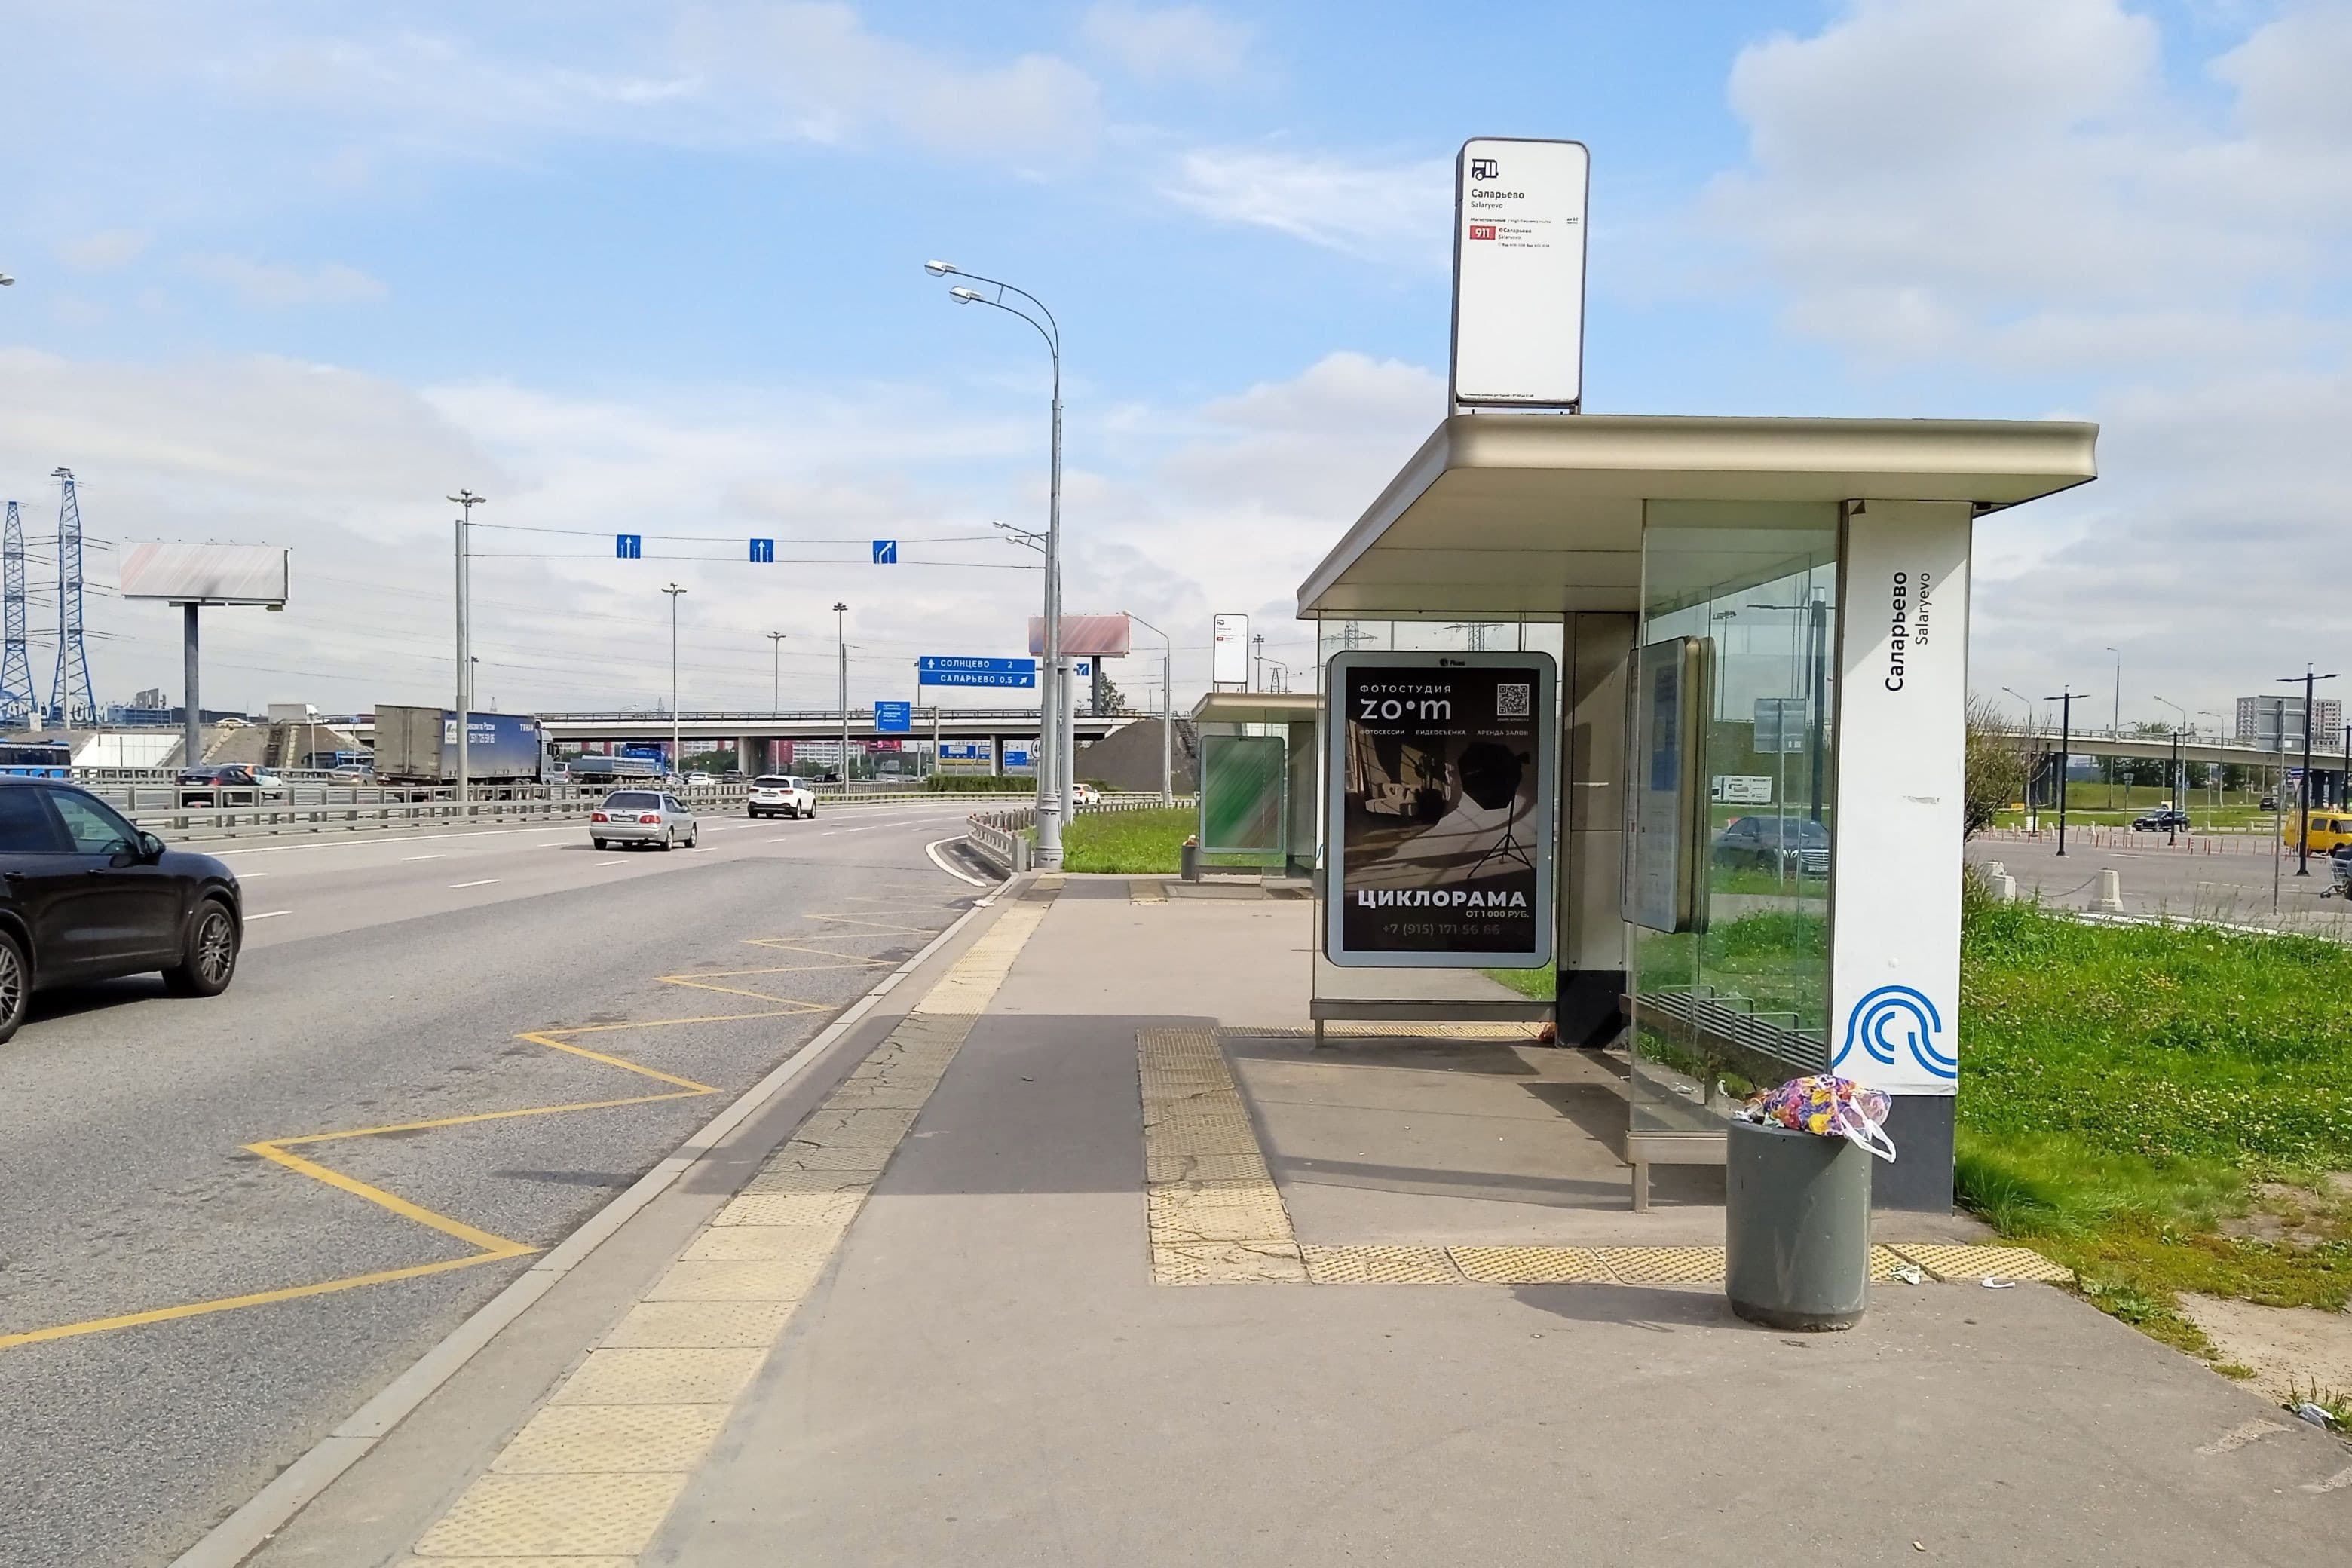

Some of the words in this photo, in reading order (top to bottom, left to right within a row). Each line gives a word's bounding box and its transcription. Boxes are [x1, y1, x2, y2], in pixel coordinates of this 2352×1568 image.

[1471, 188, 1525, 200] Саларьево
[1475, 228, 1490, 238] 911
[1915, 572, 1932, 645] Salaryevo
[1885, 571, 1909, 692] Саларьево
[940, 659, 990, 669] СОЛНЦЕВО
[940, 675, 995, 683] САЛАРЬЕВО
[1000, 676, 1012, 684] 0,5
[1360, 684, 1451, 694] ФОТОСТУДИЯ
[1358, 890, 1527, 909] ЦИКЛОРАМА
[1465, 910, 1480, 918] ОТ
[1508, 911, 1530, 919] РУБ.
[1383, 923, 1398, 935] +7
[1403, 923, 1434, 936] (915)
[1438, 923, 1457, 935] 171
